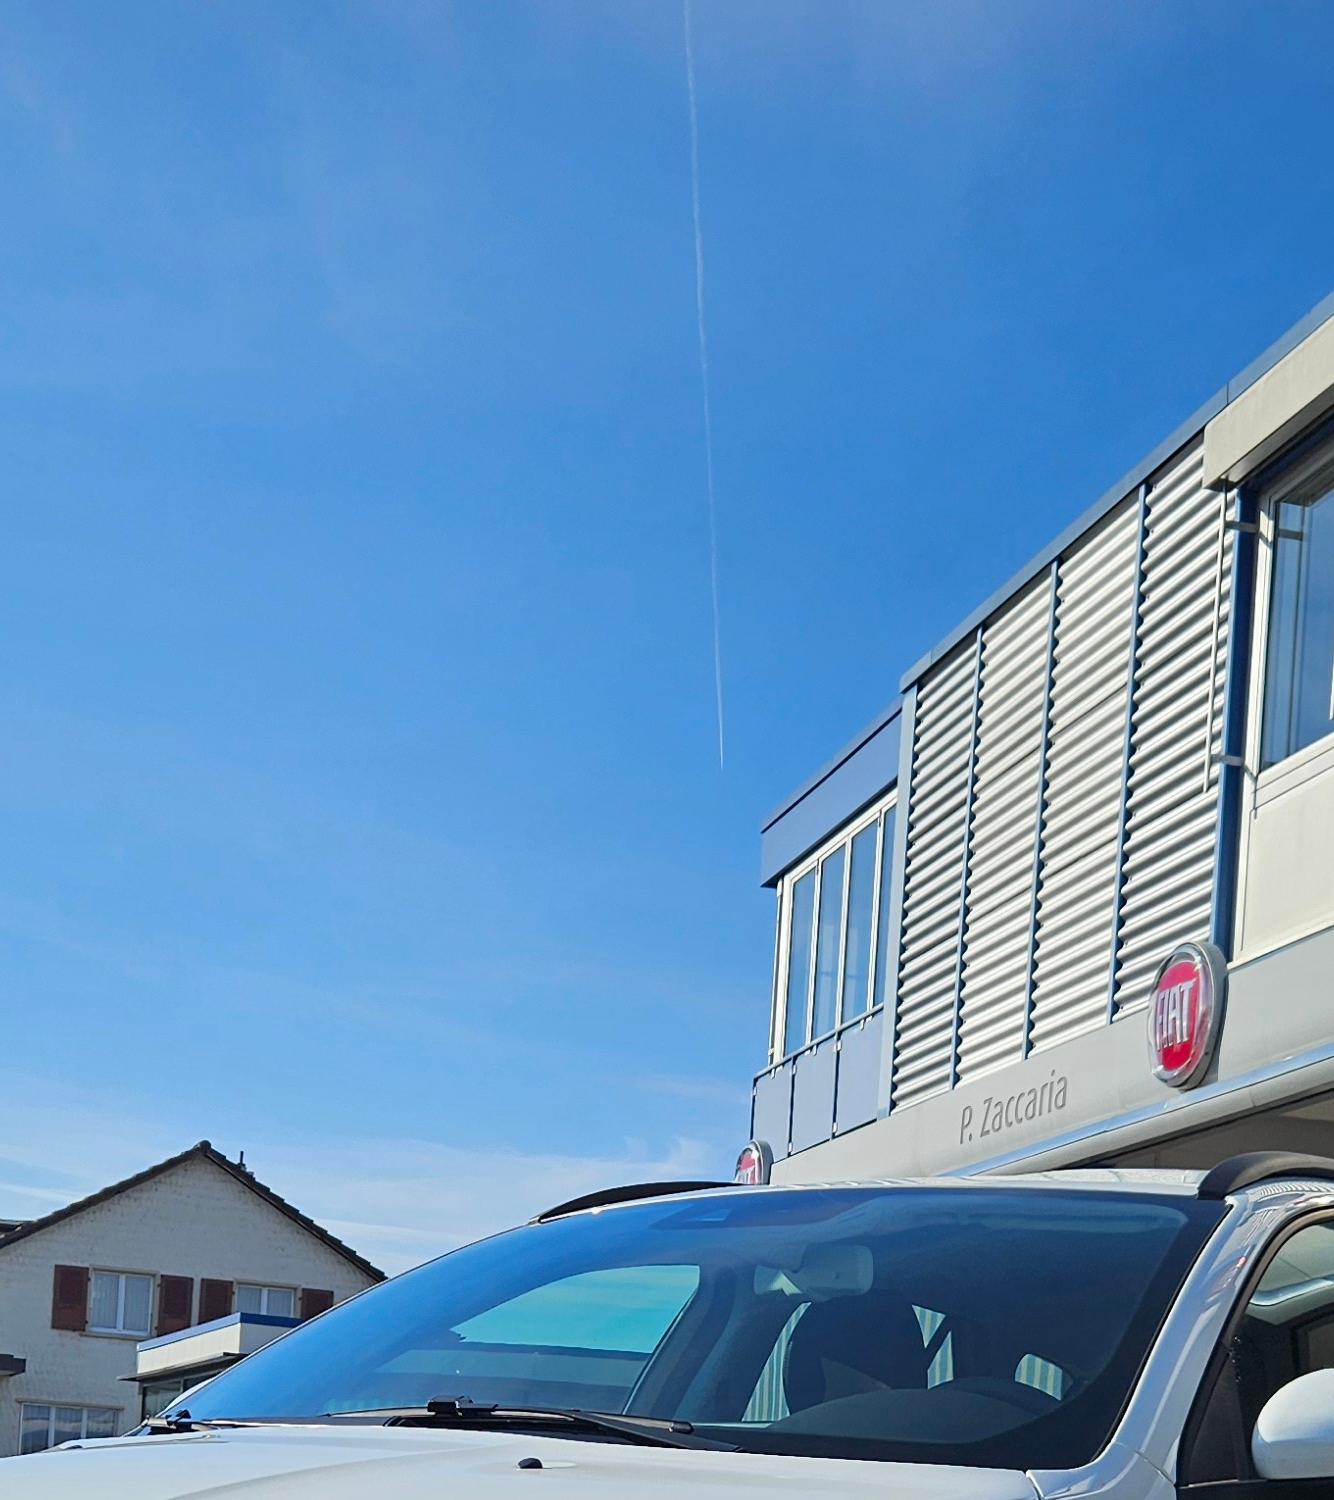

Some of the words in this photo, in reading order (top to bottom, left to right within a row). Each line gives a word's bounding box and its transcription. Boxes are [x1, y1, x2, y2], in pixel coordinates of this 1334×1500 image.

[1156, 978, 1196, 1051] FIAT
[960, 1105, 972, 1144] P.
[980, 1069, 1067, 1137] Zaccaria
